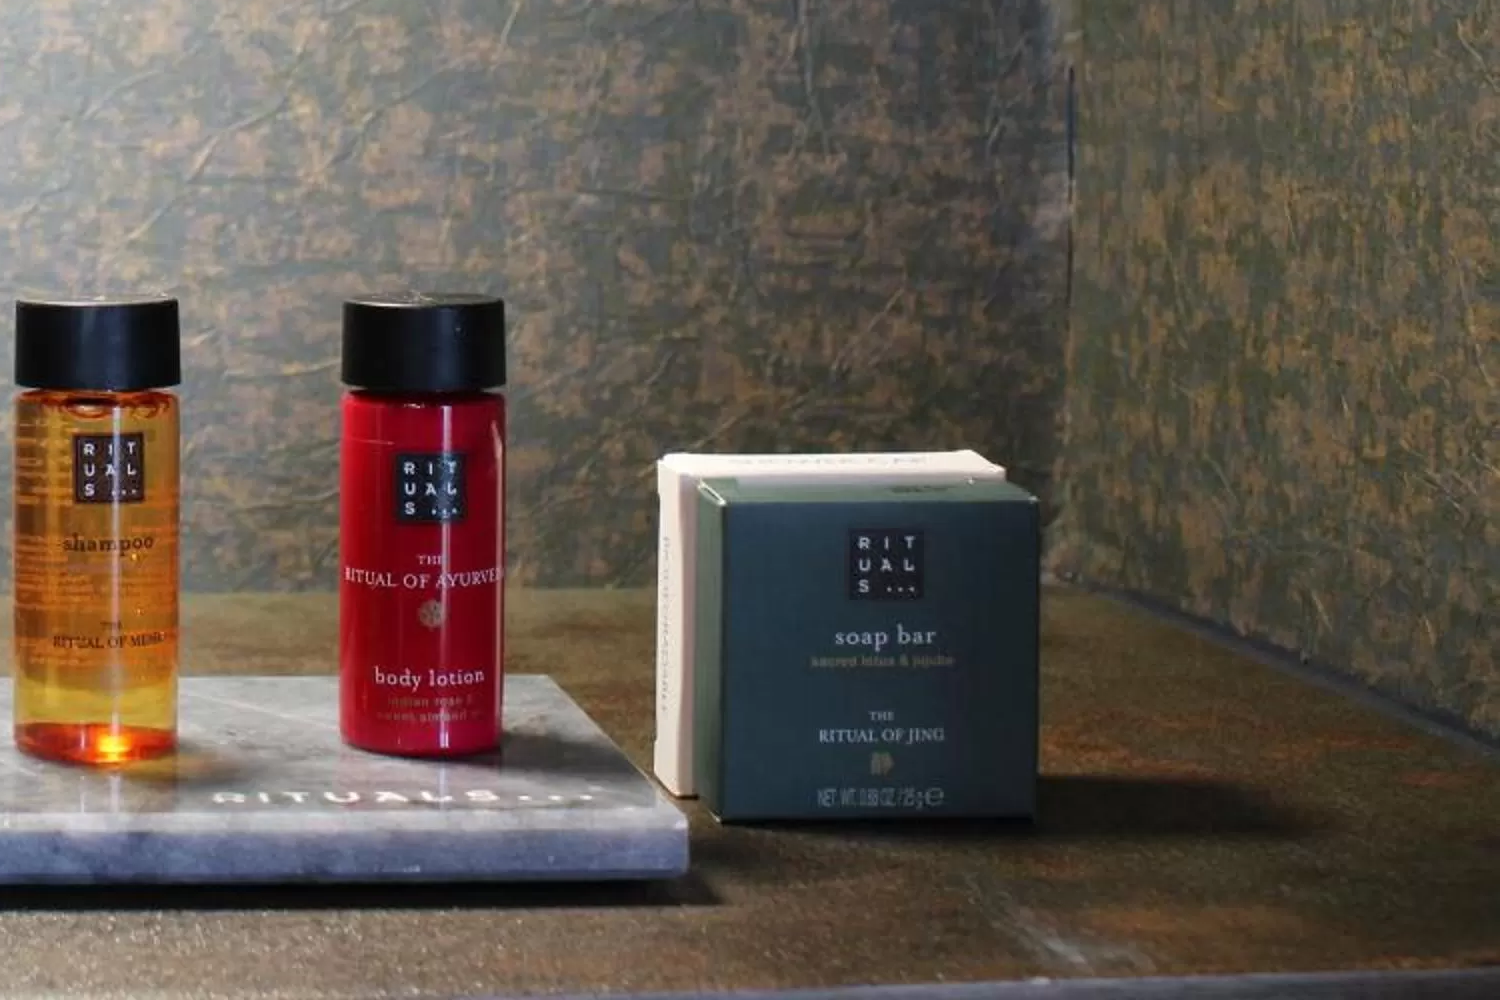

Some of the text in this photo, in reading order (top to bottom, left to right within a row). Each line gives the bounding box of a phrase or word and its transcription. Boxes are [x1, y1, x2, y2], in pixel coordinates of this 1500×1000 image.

[62, 532, 154, 557] shampoo
[403, 573, 431, 589] OF
[834, 623, 937, 653] soap bar
[374, 665, 485, 693] body lotion
[867, 711, 895, 721] THE
[819, 727, 945, 745] RITUAL OF JING
